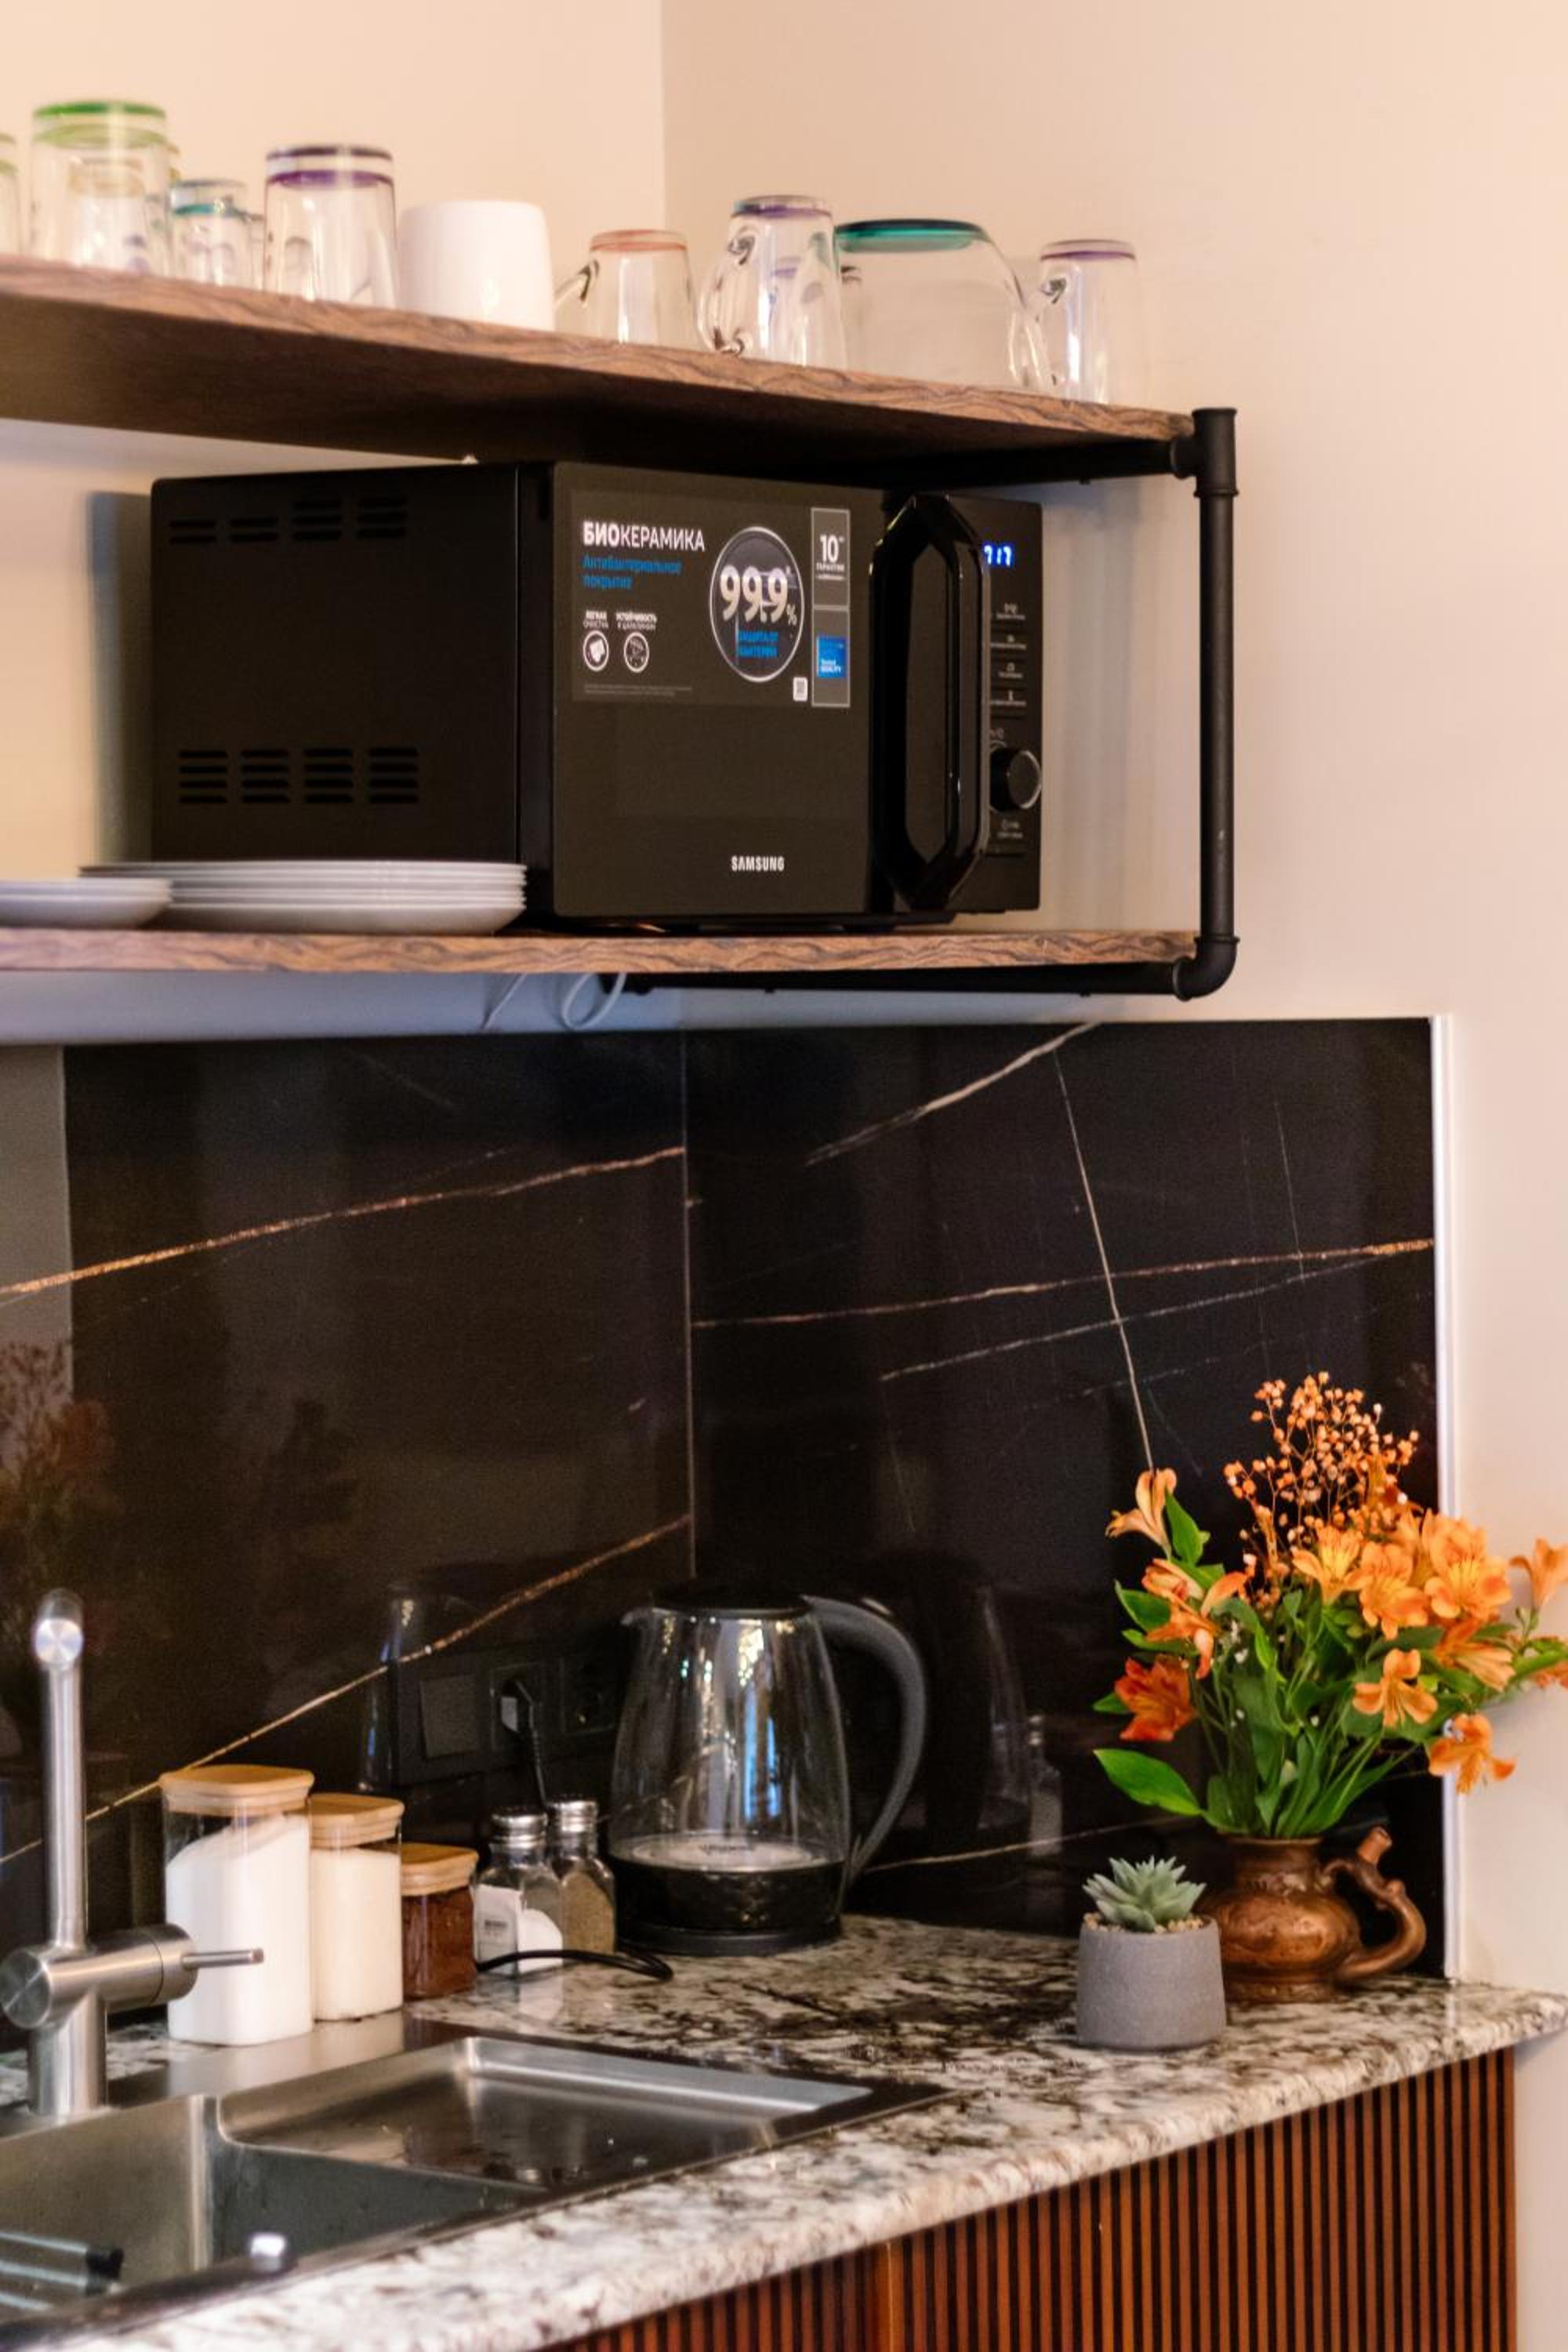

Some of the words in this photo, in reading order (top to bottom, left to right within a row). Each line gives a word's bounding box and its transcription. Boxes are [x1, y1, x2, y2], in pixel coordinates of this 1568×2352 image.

[583, 521, 705, 552] БИОКЕРАМИКА
[820, 534, 839, 563] 10
[731, 855, 785, 872] SAMSUNG
